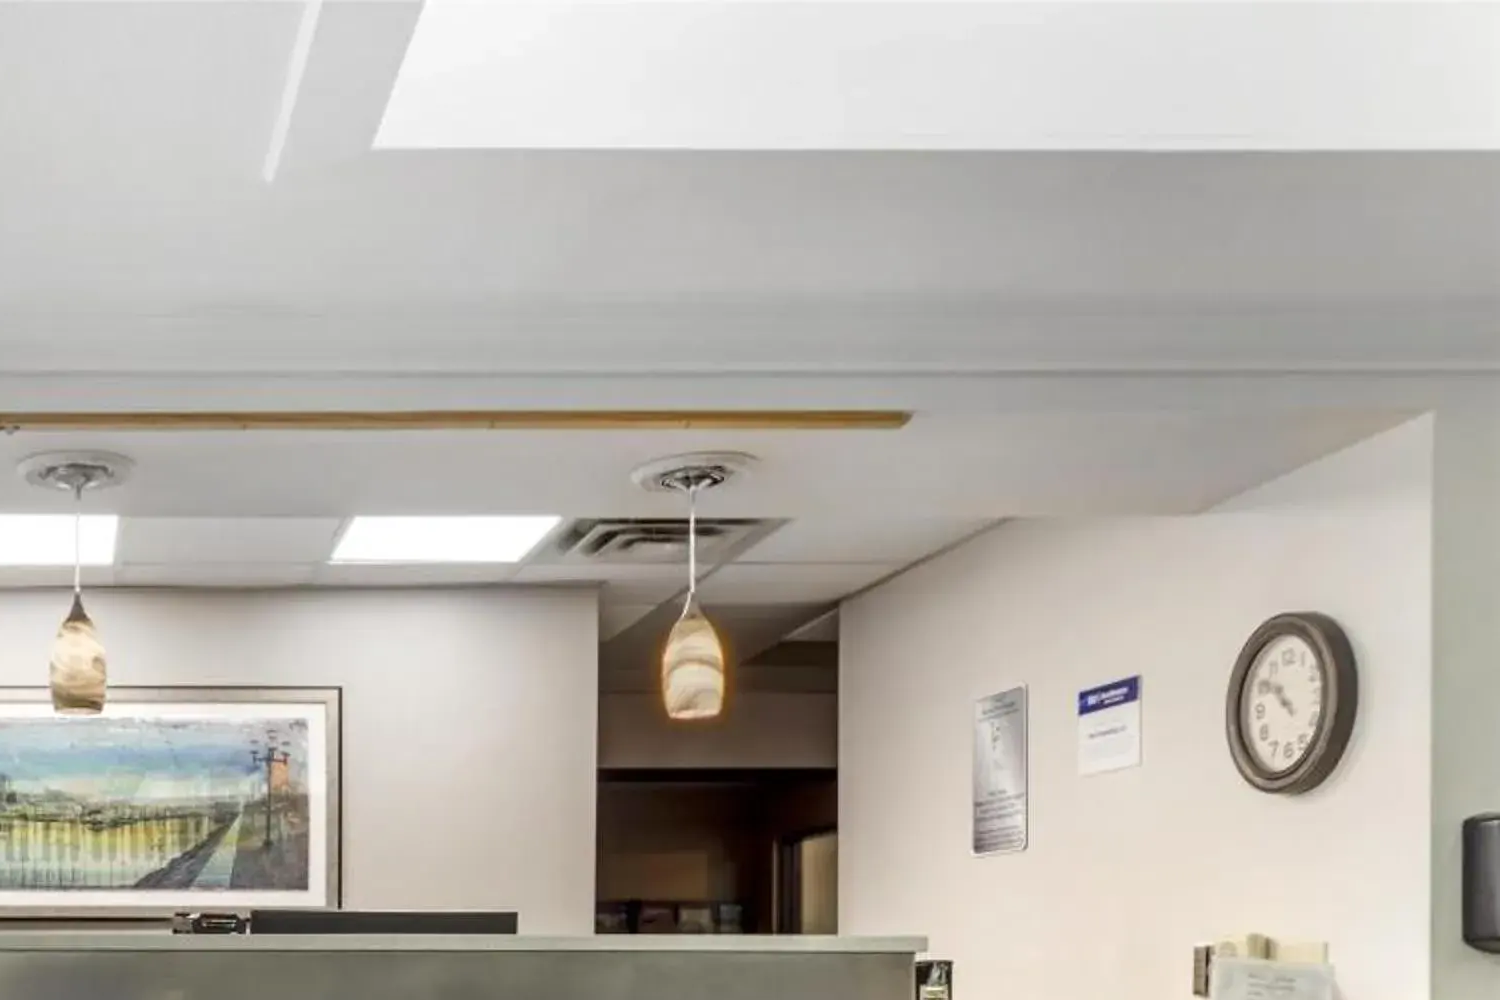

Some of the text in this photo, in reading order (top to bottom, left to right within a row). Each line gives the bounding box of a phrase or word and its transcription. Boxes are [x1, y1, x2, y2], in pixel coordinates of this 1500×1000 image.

[1282, 647, 1296, 667] 12
[1300, 651, 1306, 667] 1
[1268, 660, 1279, 677] 11
[1255, 702, 1266, 721] 9
[1259, 724, 1269, 742] 8
[1268, 740, 1279, 757] 7
[1283, 741, 1294, 759] 6
